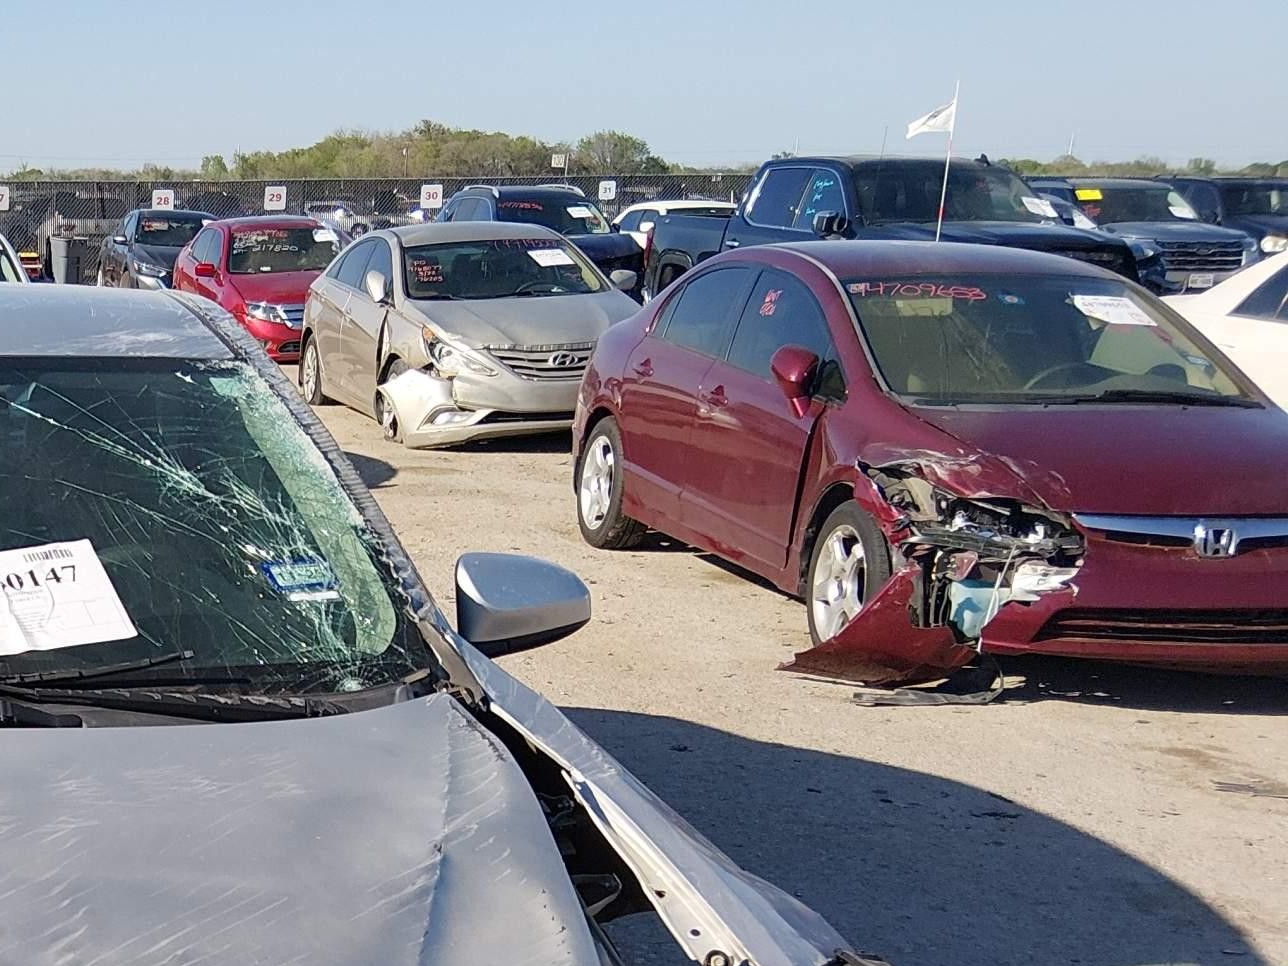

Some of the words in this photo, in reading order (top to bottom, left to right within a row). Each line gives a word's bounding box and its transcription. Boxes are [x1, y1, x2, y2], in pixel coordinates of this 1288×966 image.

[602, 186, 611, 194] 31
[269, 193, 282, 202] 29
[425, 191, 438, 200] 30
[157, 197, 170, 206] 28
